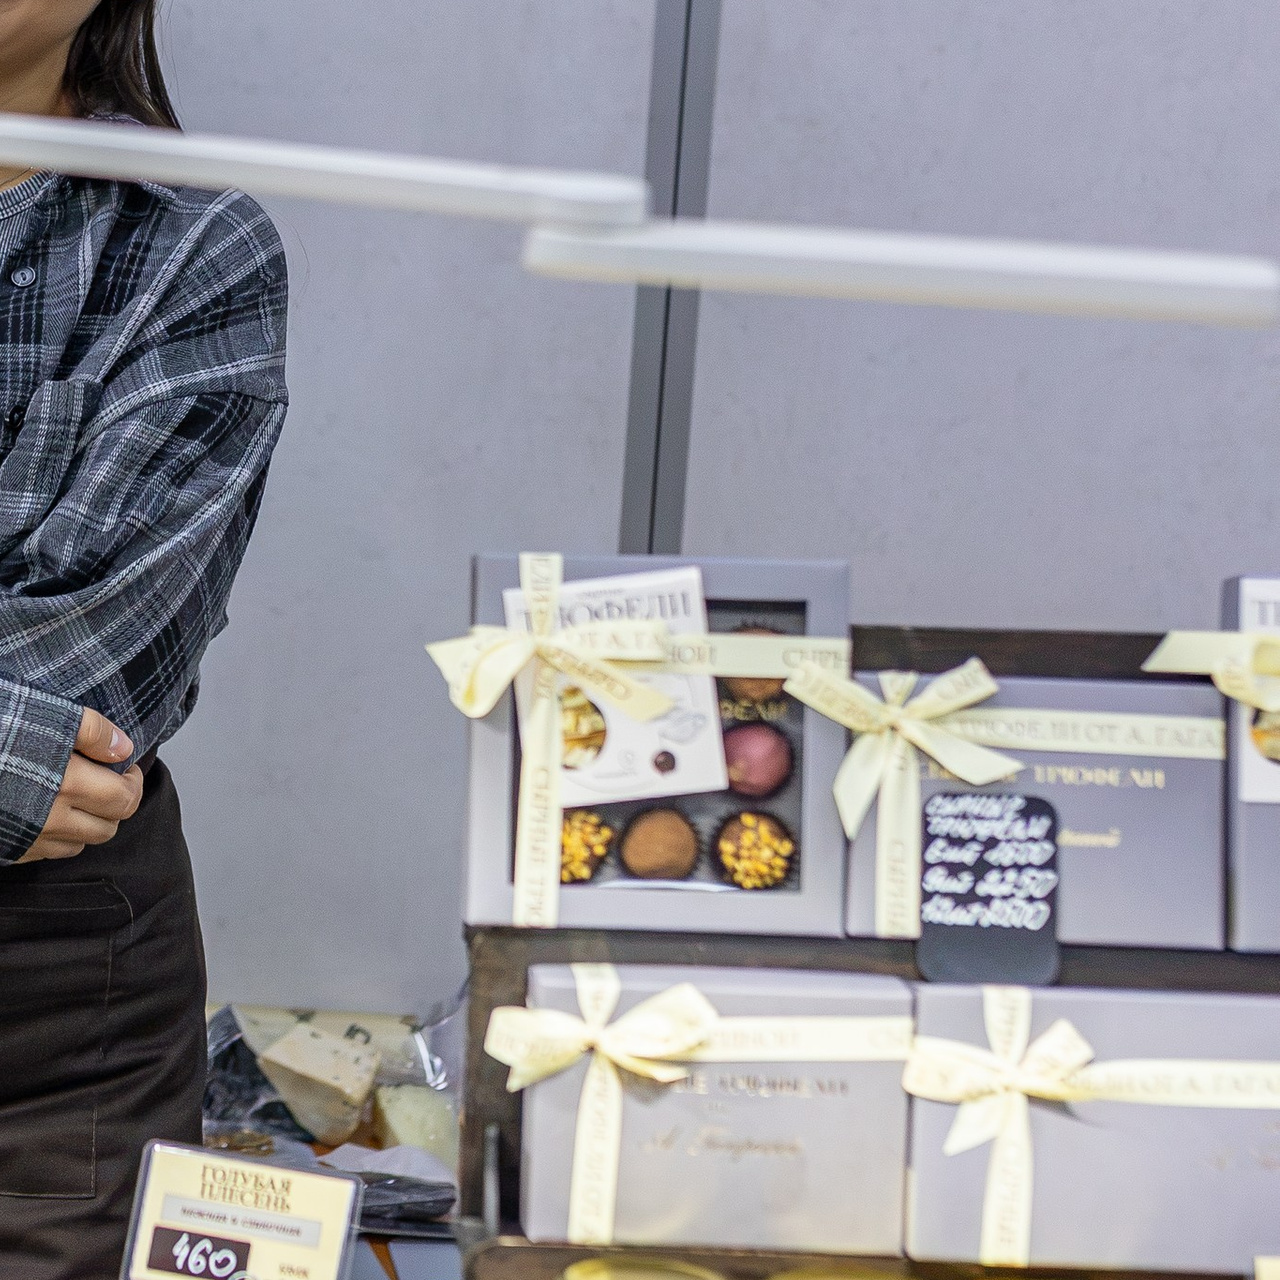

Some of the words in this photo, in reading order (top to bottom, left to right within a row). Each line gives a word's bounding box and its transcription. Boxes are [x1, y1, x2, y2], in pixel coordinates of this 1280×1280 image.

[520, 590, 691, 628] ТЮФЕЛИ
[200, 1182, 292, 1214] ПЛЕСЕНЬ
[201, 1164, 293, 1197] ГОЛУБАЯ
[171, 1232, 238, 1279] 460
